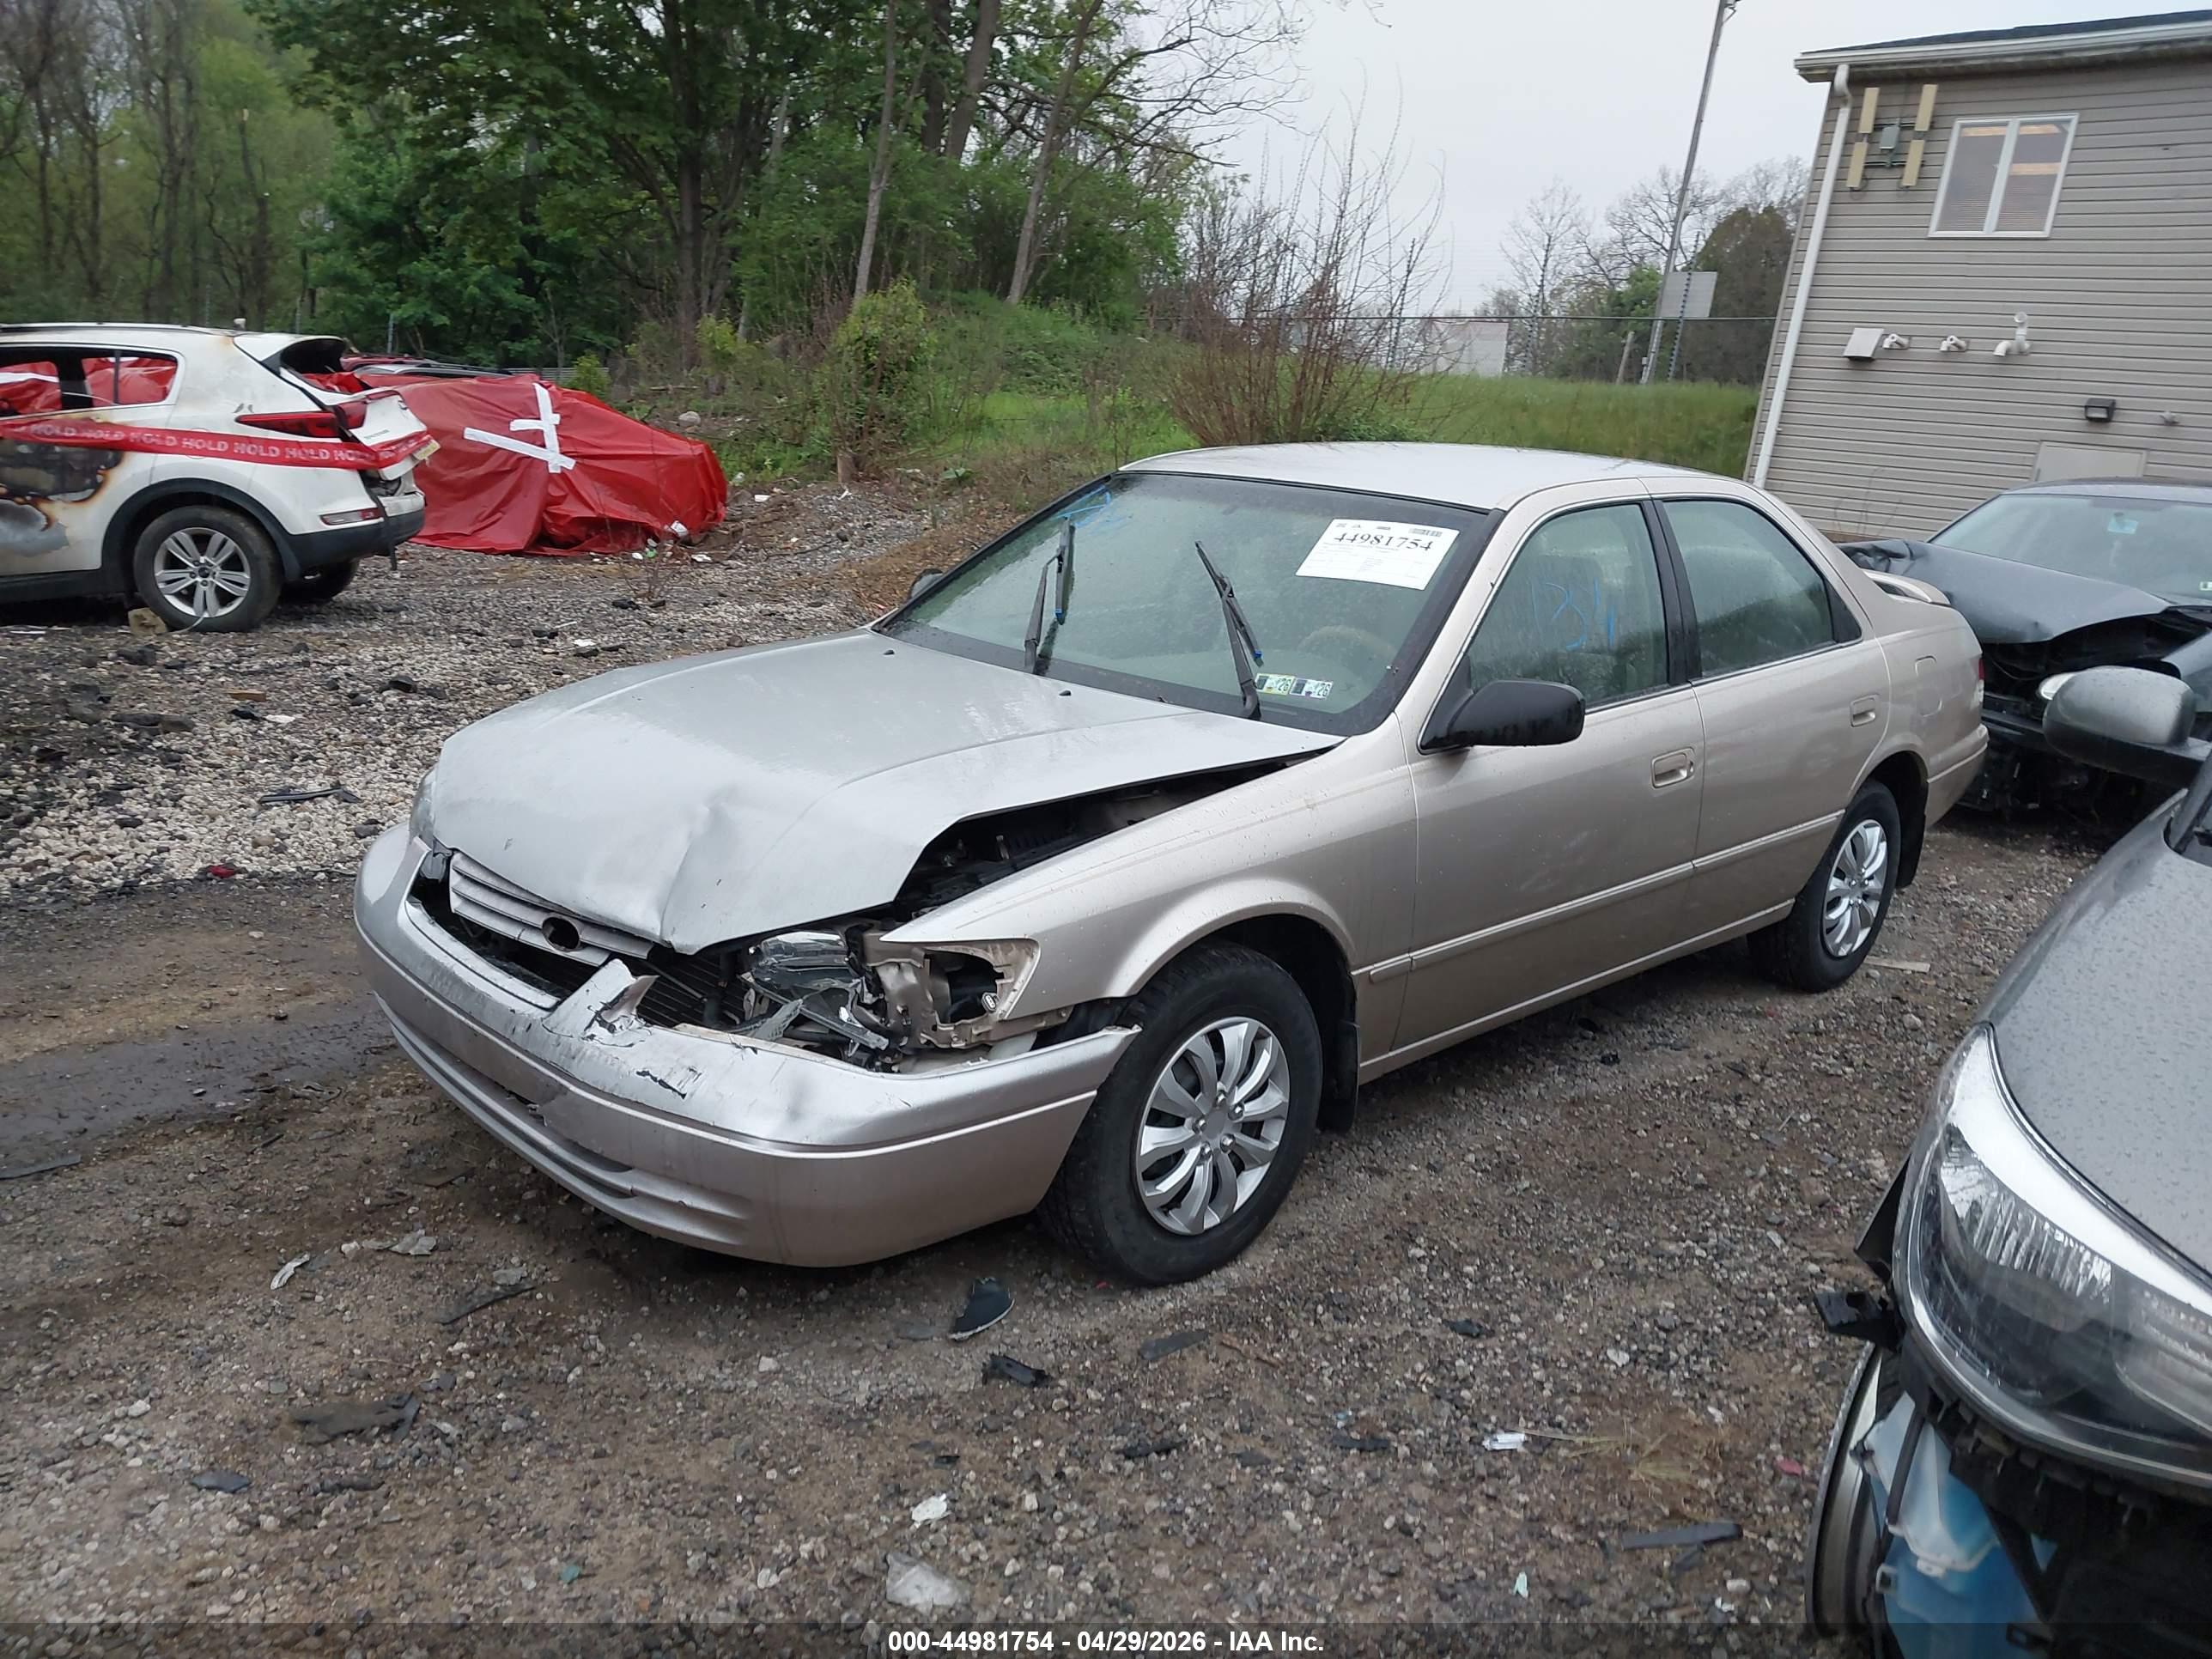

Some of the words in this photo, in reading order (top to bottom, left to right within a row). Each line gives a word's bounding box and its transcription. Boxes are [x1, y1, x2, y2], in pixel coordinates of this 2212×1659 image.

[130, 432, 177, 446] HOLD
[182, 436, 229, 453] HOLD
[234, 441, 280, 458] HOLD
[284, 447, 331, 460] HOLD
[1334, 532, 1434, 551] 44981754
